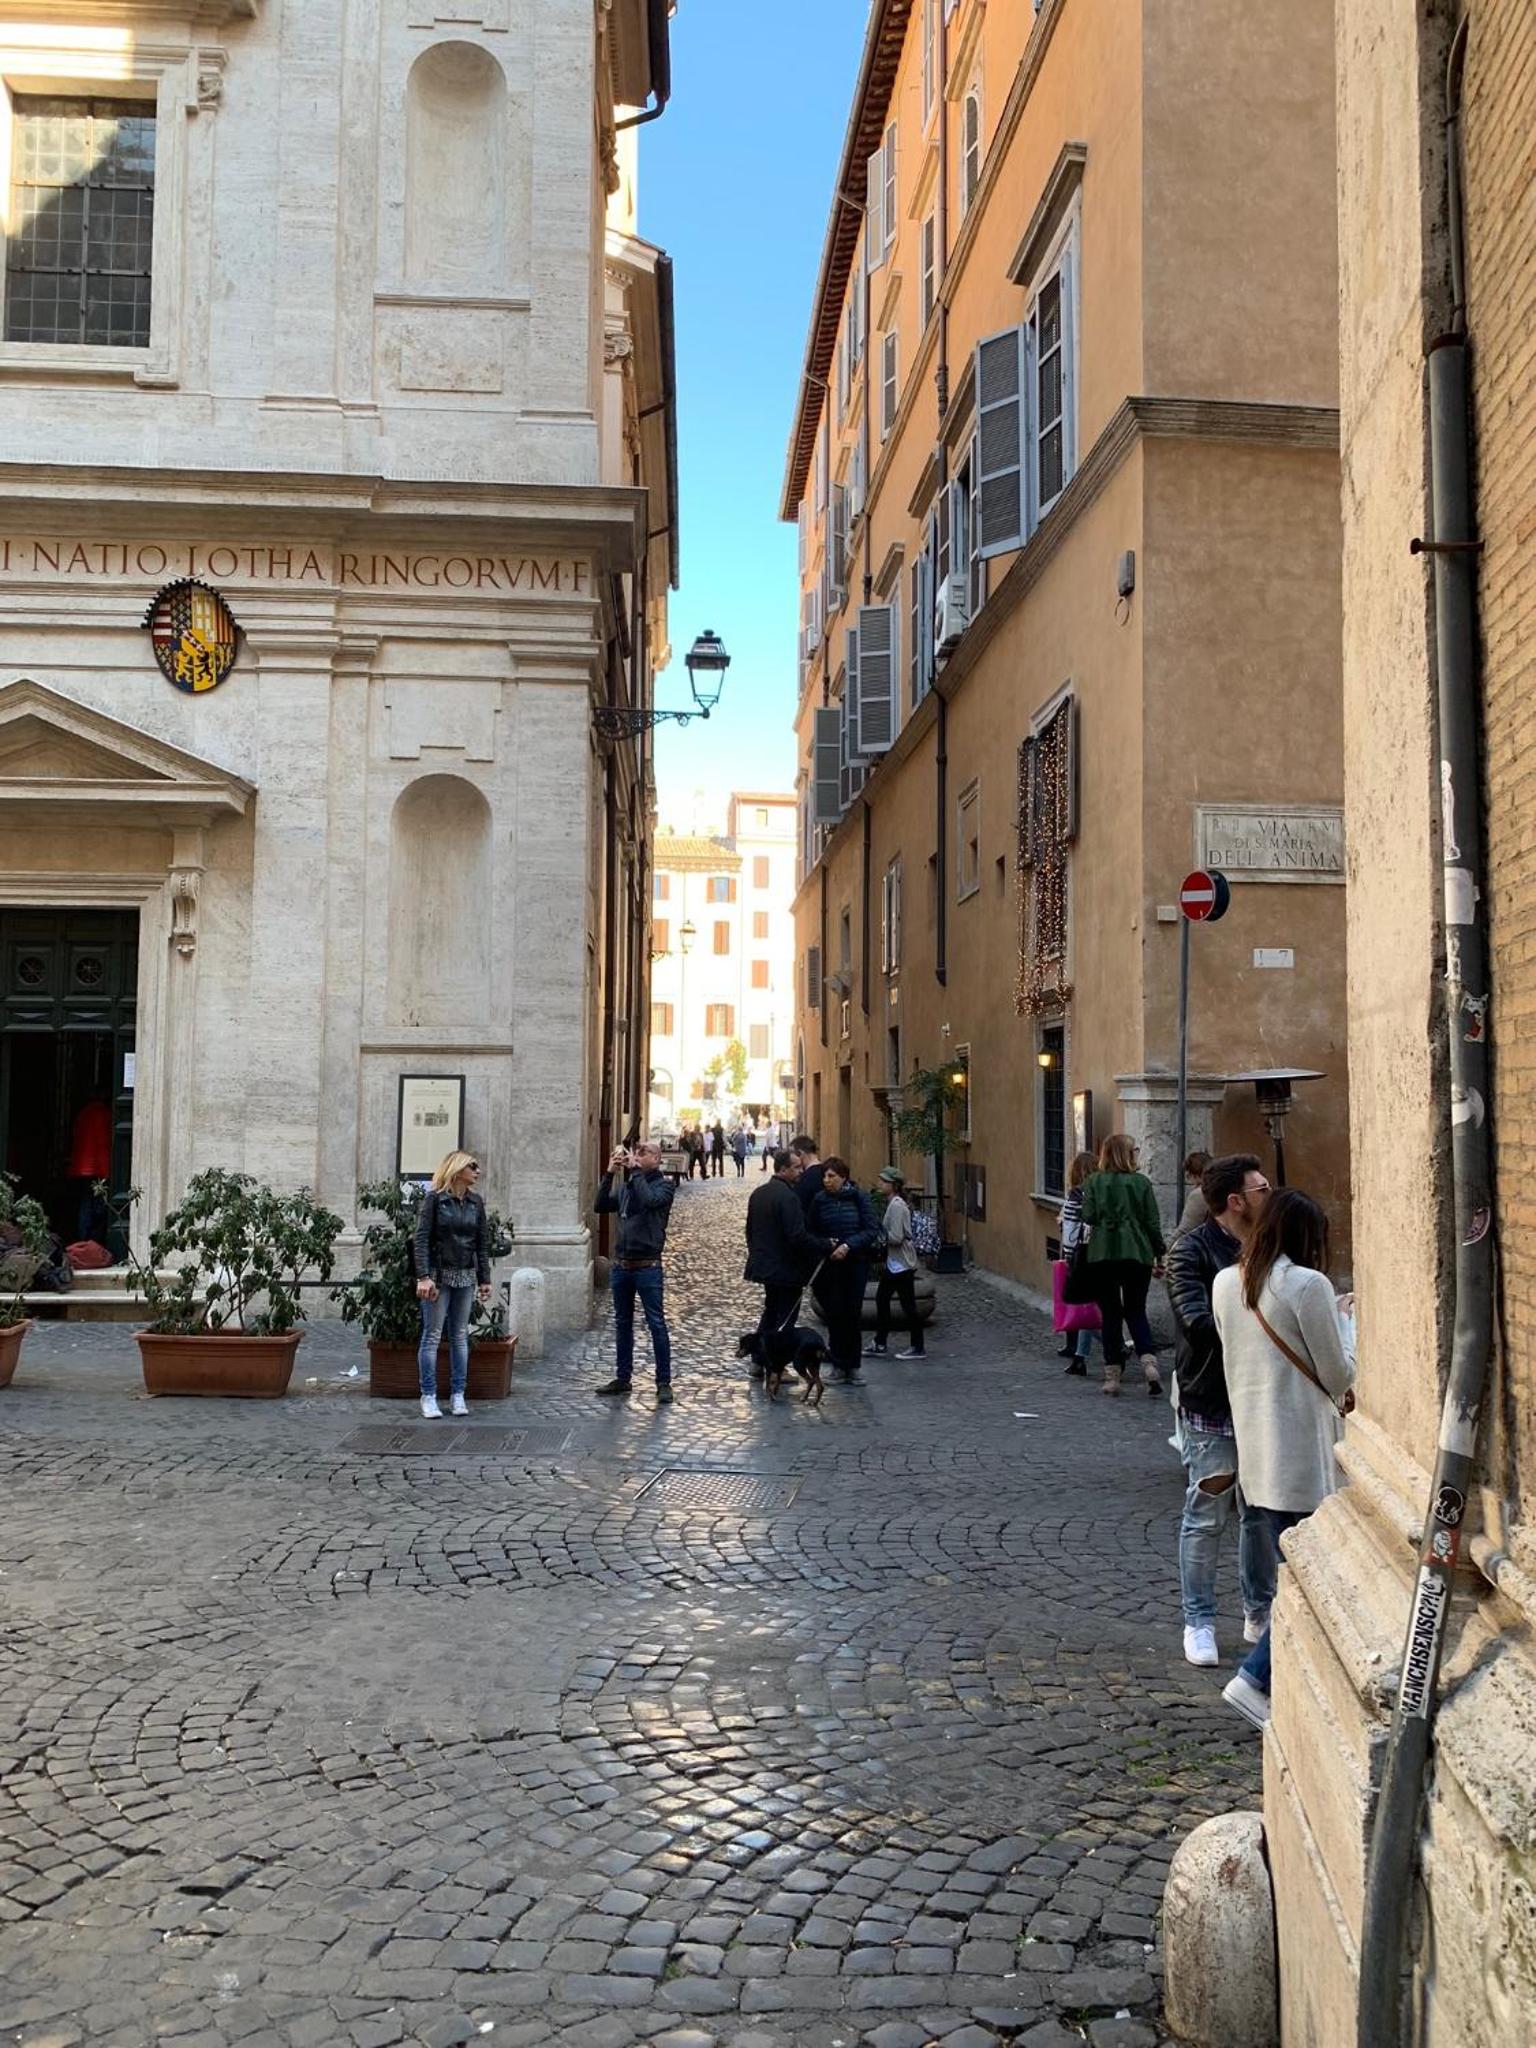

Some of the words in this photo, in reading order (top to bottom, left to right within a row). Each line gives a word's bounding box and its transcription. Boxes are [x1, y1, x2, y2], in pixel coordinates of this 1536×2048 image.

[33, 541, 168, 575] NATIO
[1258, 820, 1291, 836] VIA
[1235, 838, 1249, 849] DI
[1269, 838, 1314, 850] MARIA
[1271, 851, 1340, 867] ANIMA
